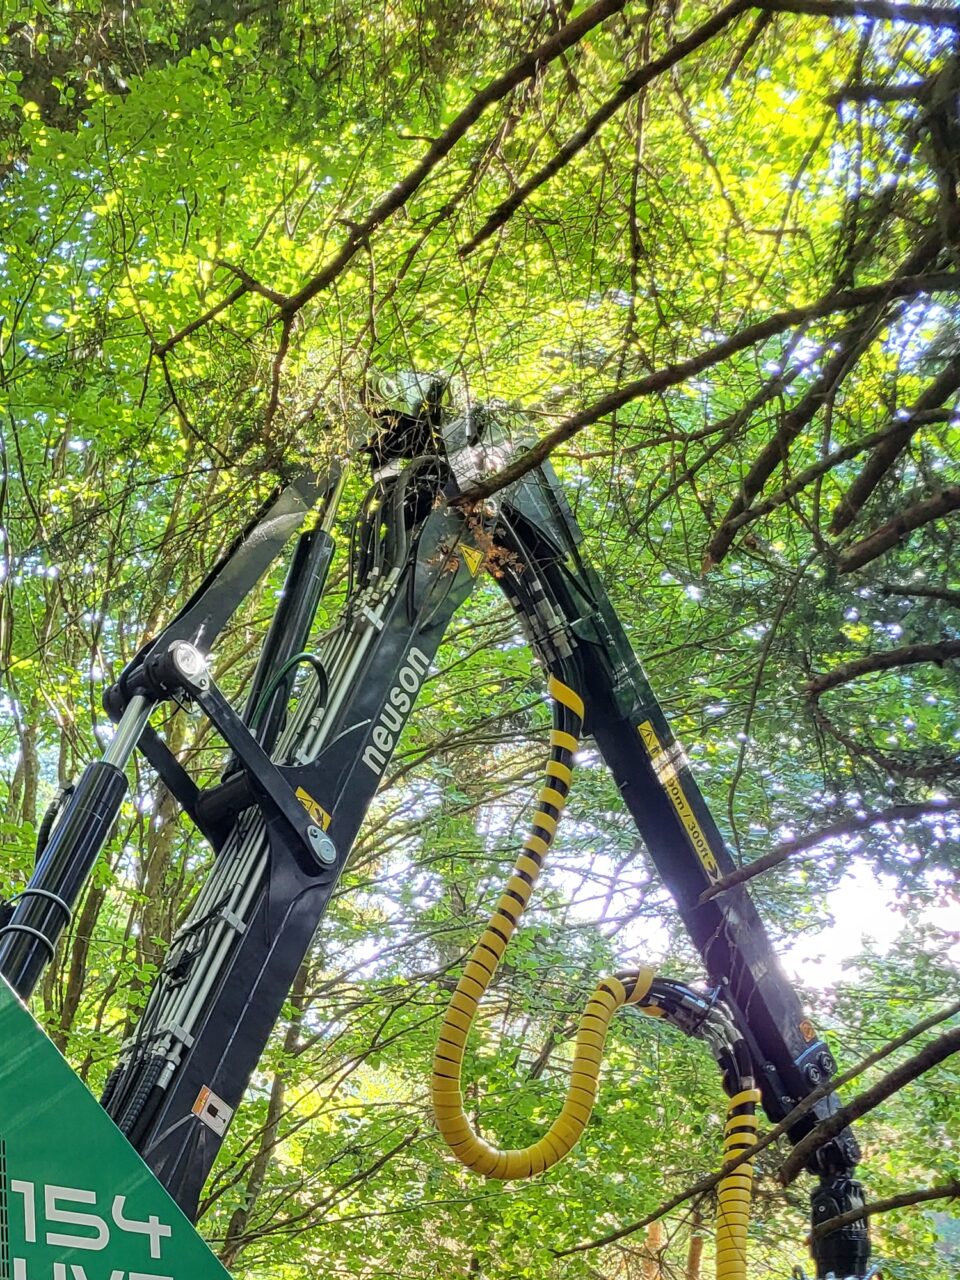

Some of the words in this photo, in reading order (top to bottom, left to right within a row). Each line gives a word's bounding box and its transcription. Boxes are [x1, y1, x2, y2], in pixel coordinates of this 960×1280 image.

[361, 646, 430, 775] neuson
[688, 822, 709, 858] 300ft
[11, 1180, 172, 1259] 154
